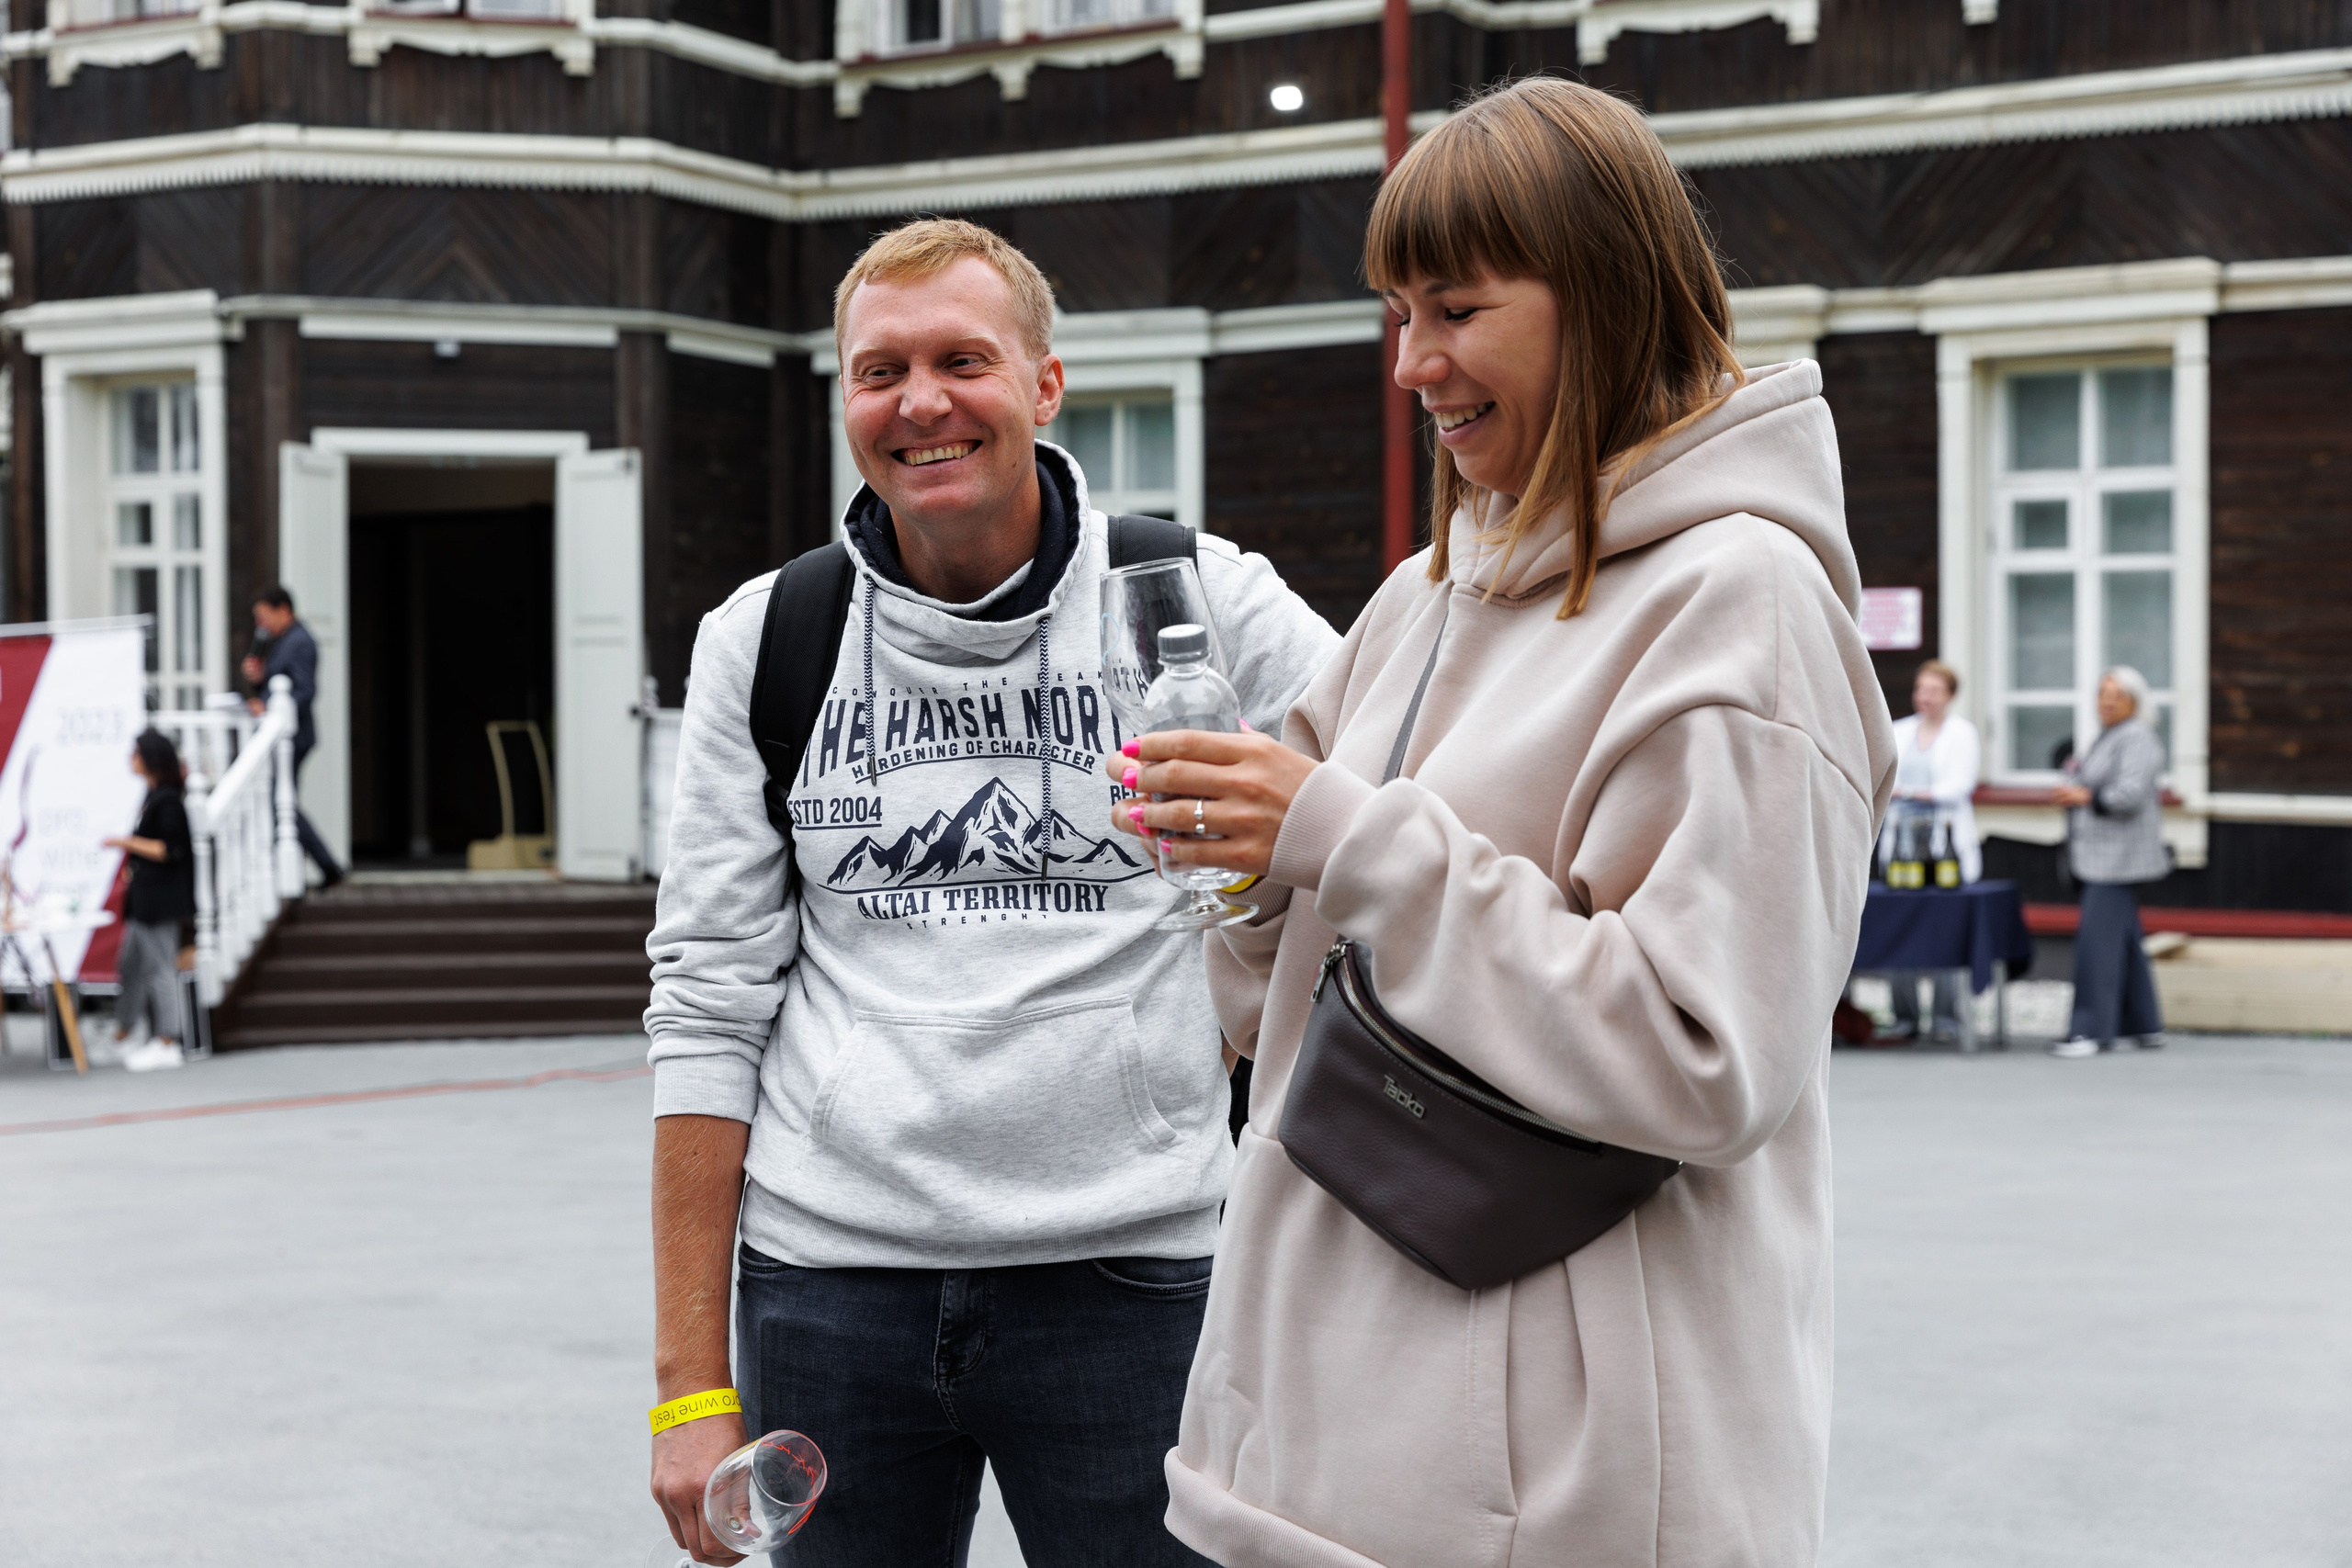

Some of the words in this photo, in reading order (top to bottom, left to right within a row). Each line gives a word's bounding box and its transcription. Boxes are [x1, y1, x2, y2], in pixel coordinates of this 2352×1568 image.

[963, 677, 1008, 691] THE
[885, 693, 1008, 752] HARSH
[966, 739, 984, 754] OF
[830, 795, 882, 824] 2004
[857, 891, 932, 919] ALTAI
[943, 883, 1109, 913] TERRITORY
[678, 1397, 718, 1416] wine
[654, 1408, 676, 1427] fest
